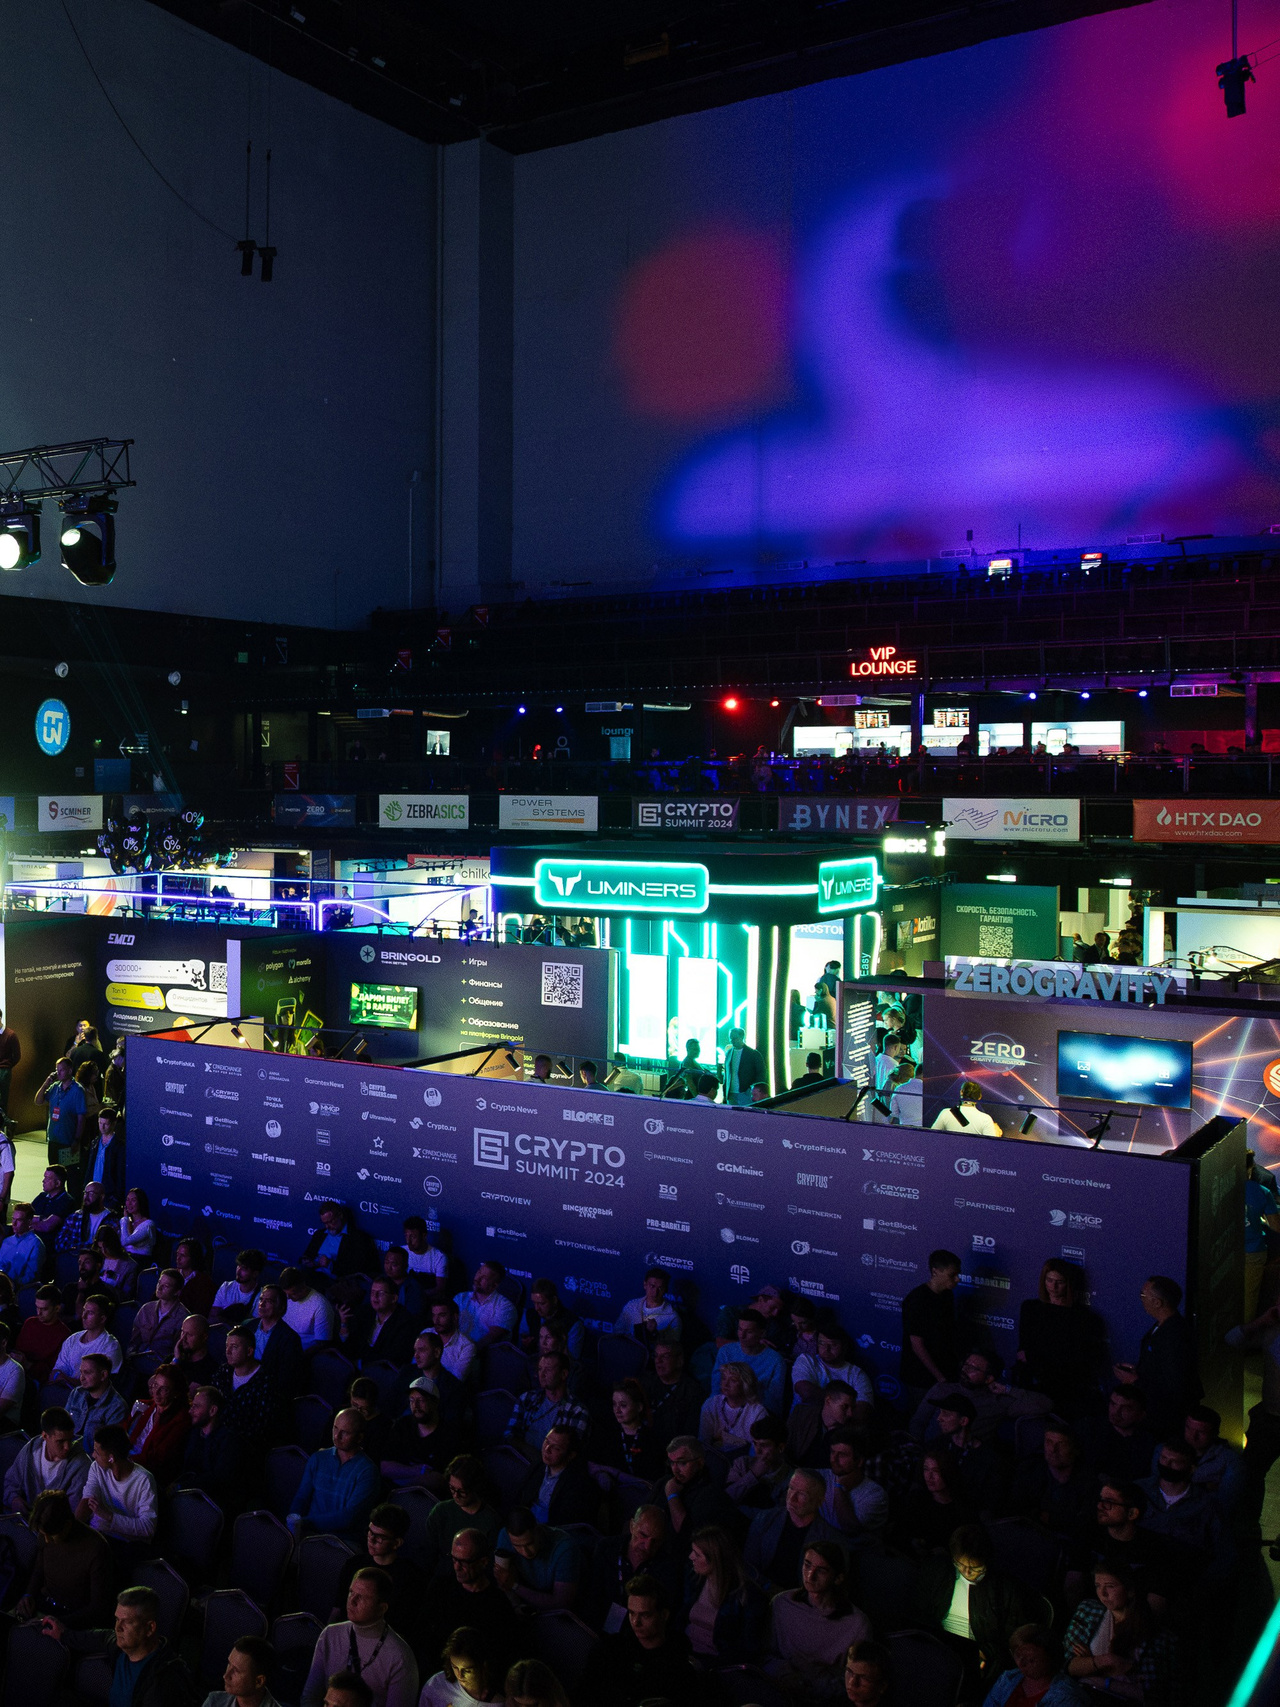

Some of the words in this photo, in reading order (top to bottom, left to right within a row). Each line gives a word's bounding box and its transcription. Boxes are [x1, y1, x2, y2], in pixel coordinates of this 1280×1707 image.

[870, 647, 896, 660] VIP
[851, 660, 917, 675] LOUNGE
[601, 726, 634, 737] loung
[511, 799, 552, 807] POWER
[60, 807, 91, 816] SCMINER
[407, 804, 465, 819] ZEBRASICS
[532, 808, 585, 816] SYSTEMS
[664, 803, 733, 817] CRYPTO
[665, 818, 705, 828] SUMMIT
[708, 820, 733, 828] 2024
[1176, 812, 1215, 826] HTX
[1220, 812, 1262, 827] DAO
[1174, 829, 1243, 837] www.htxdao.com
[123, 838, 139, 851] 0%
[163, 838, 181, 851] 0%
[587, 879, 697, 898] UMINERS
[835, 876, 872, 897] UMINERS
[380, 950, 441, 964] BRINGOLD
[468, 958, 488, 967] Игры
[265, 961, 284, 971] polygon
[860, 952, 871, 977] Easy
[468, 978, 503, 989] Финансы
[954, 963, 1172, 1005] ZEROGRAVITY
[468, 996, 504, 1007] Общение
[113, 1012, 137, 1021] Академия
[468, 1017, 519, 1030] Образование
[500, 1034, 524, 1042] Bringold
[970, 1040, 1026, 1059] ZERO
[163, 1058, 195, 1068] CryptoFishKA
[304, 1077, 345, 1089] GarantexNews
[320, 1105, 340, 1113] MMGP
[490, 1102, 516, 1113] Crypto
[516, 1105, 538, 1115] News
[214, 1116, 239, 1126] GetBlock
[370, 1113, 397, 1124] Ultramining
[426, 1121, 457, 1132] Crypto.ru
[666, 1125, 694, 1135] FINFORUM
[728, 1133, 764, 1144] bits.media
[369, 1149, 389, 1158] Insider
[514, 1133, 626, 1168] CRYPTO
[794, 1142, 847, 1155] CryptoFishKA
[654, 1154, 693, 1165] PARTNERKIN
[875, 1150, 925, 1164] CPAEXCHANGE
[515, 1160, 580, 1181] SUMMIT
[584, 1171, 625, 1189] 2024
[982, 1166, 1017, 1177] FINFORUM
[373, 1172, 402, 1184] Crypto.ru
[797, 1172, 828, 1189] CRYPTUS
[1041, 1173, 1111, 1190] GarantexNews
[880, 1183, 920, 1194] CRYPTO
[880, 1189, 920, 1200] MEDWED
[480, 1191, 532, 1206] CRYPTOVIEW
[359, 1200, 379, 1214] CIS
[965, 1201, 1015, 1213] PARTNERKIN
[215, 1209, 241, 1221] Crypto.ru
[797, 1207, 842, 1220] PARTNERKIN
[1069, 1213, 1103, 1225] MMGP
[877, 1219, 918, 1232] GetBlock
[496, 1227, 528, 1239] GetBlock
[554, 1238, 621, 1256] CRYPTONEWS.website
[1063, 1248, 1083, 1256] MEDIA
[657, 1261, 694, 1271] MEDWED
[659, 1255, 694, 1265] CRYPTO
[878, 1256, 918, 1270] SkyPortal.Ru
[579, 1277, 608, 1291] Crypto
[800, 1279, 824, 1290] CRYPTO
[579, 1287, 595, 1296] Fox
[596, 1289, 611, 1299] Lab
[800, 1288, 840, 1301] FINGERS.com
